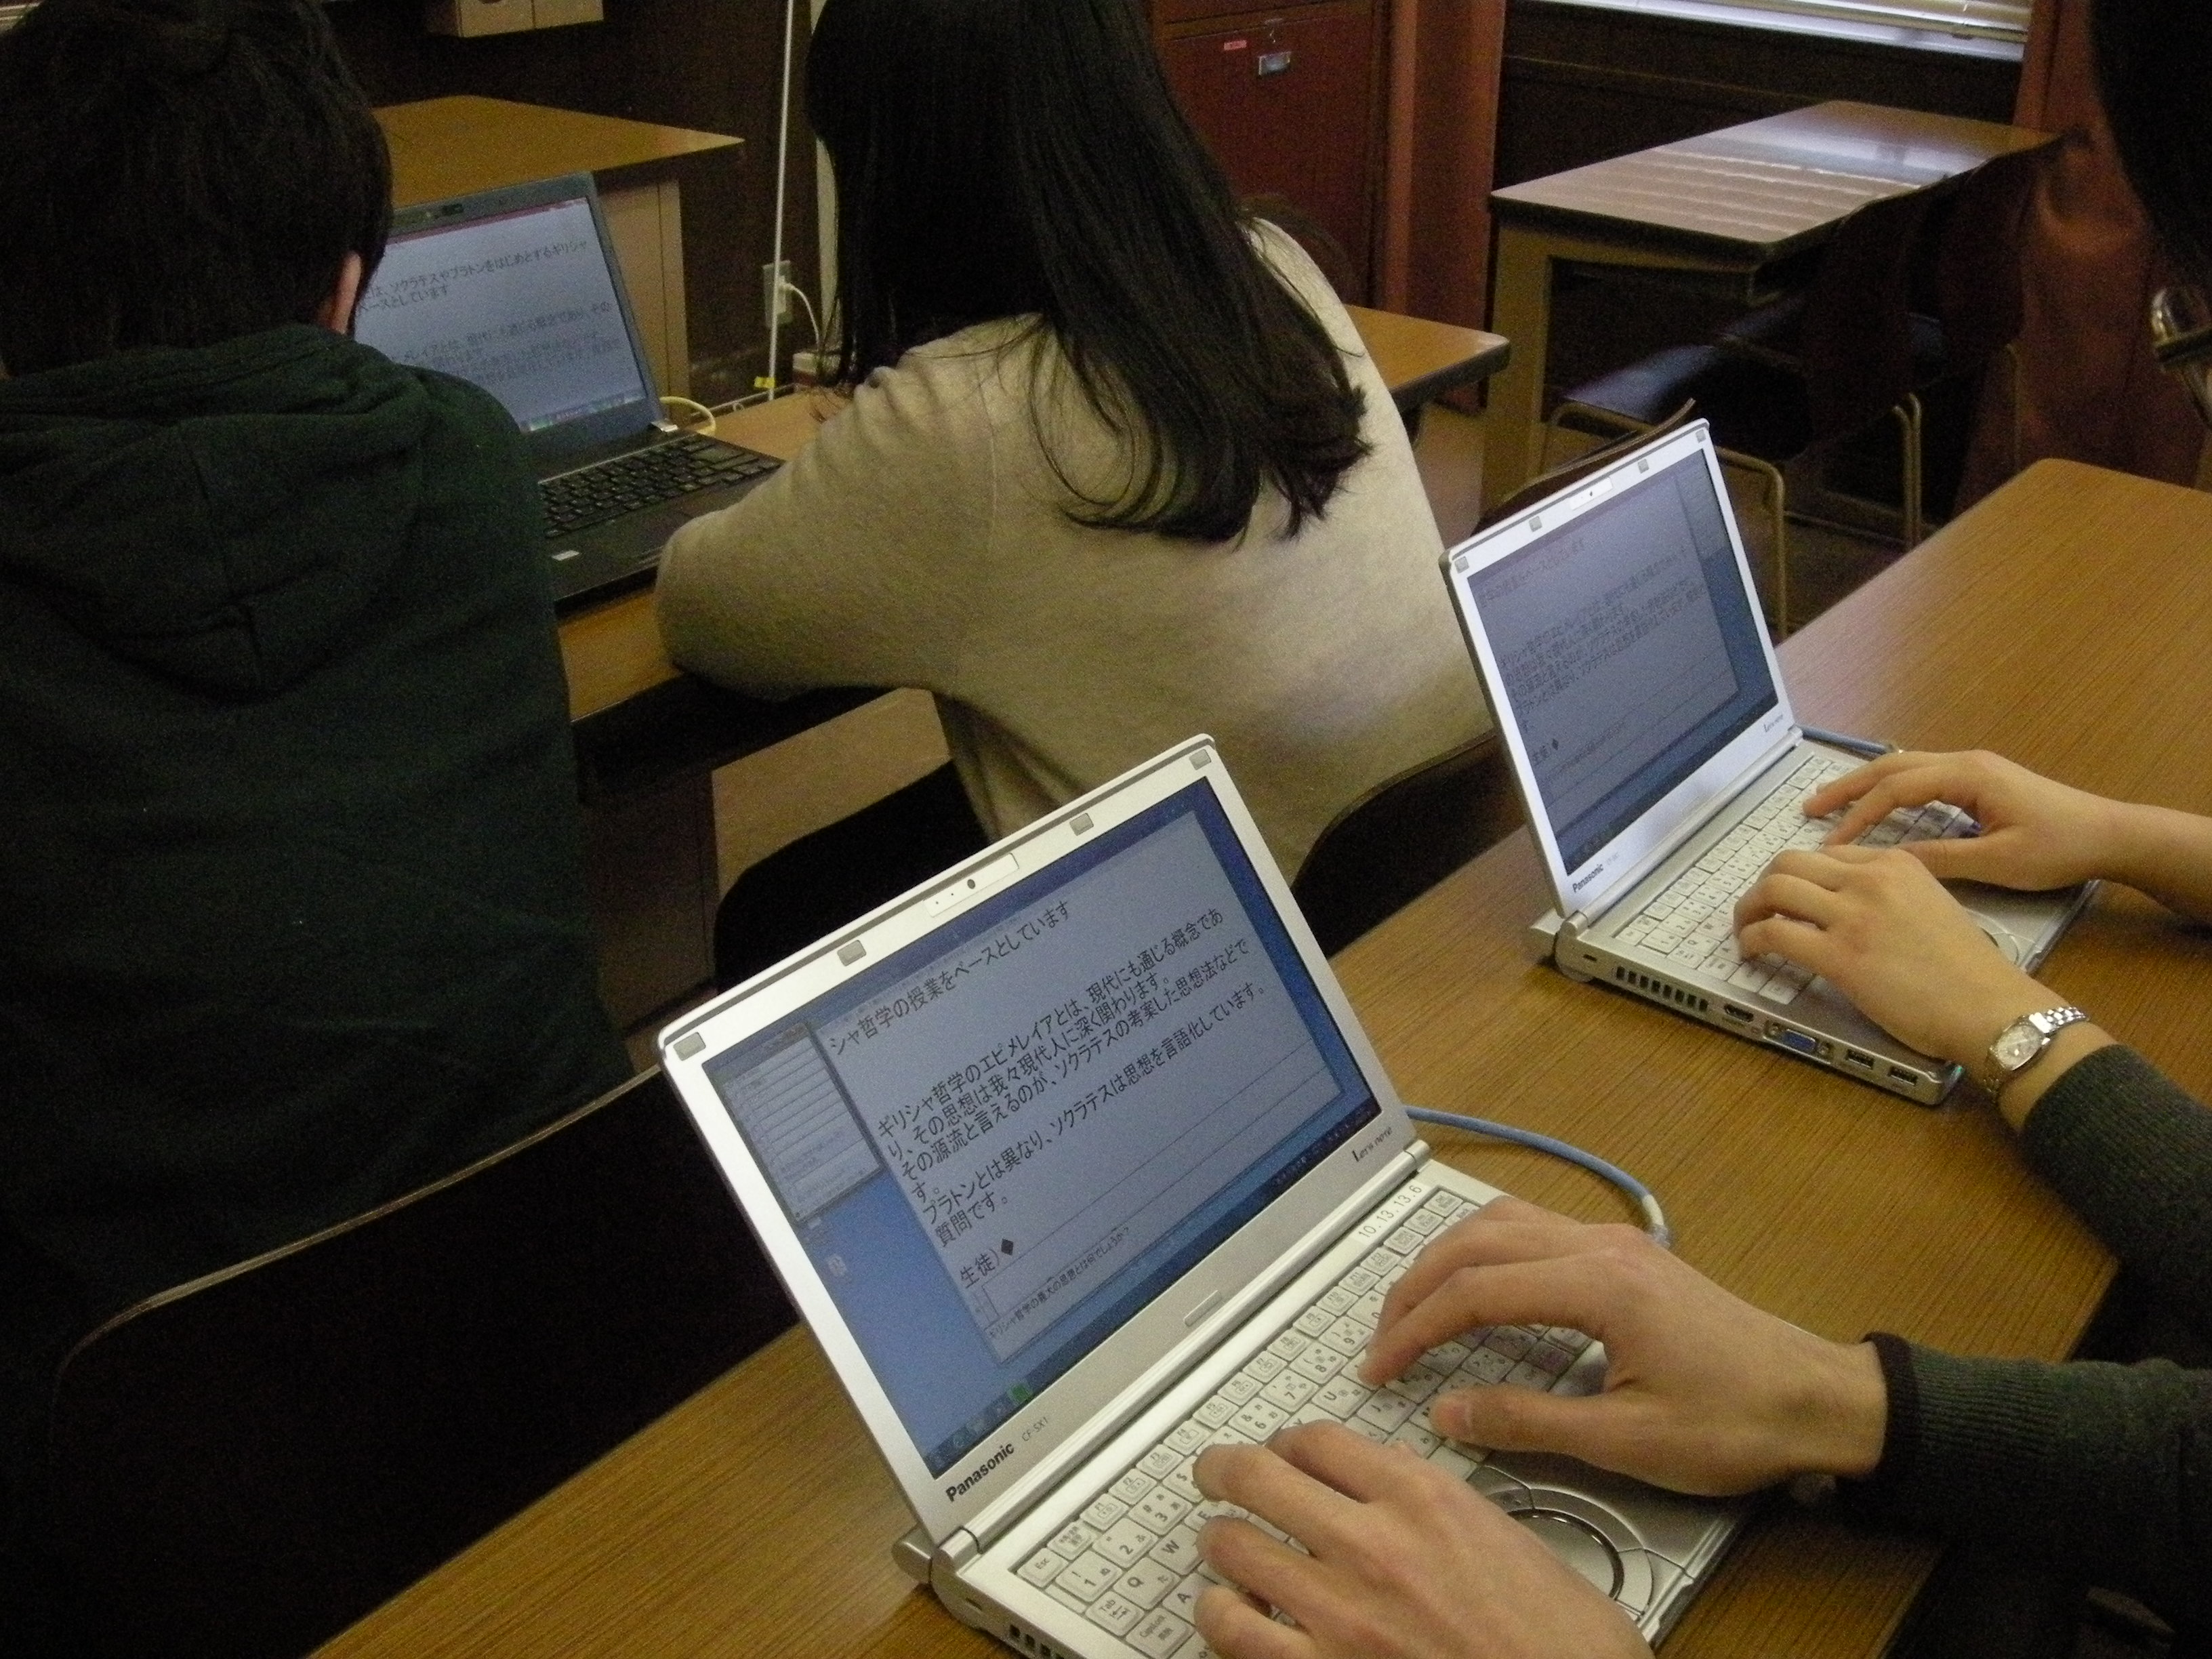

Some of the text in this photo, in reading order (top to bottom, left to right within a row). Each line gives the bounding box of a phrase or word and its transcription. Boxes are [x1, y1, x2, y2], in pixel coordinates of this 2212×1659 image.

[1572, 863, 1604, 893] Panasonic
[830, 901, 1071, 1054] シャ哲学の授業をベースとしています
[876, 908, 1222, 1140] ギリシャ哲学のエピメレイアとは、現代にも通じる概念であ
[888, 968, 1168, 1160] り、その思想は我々現代人に深く関わります。
[900, 941, 1247, 1182] その源流と言えるのが、ソクラテスの考案した思想法などで
[923, 979, 1262, 1222] プラトンとは異なり、ソクラテスは思想を言語化しています。
[911, 1174, 939, 1204] す。
[935, 1185, 1006, 1246] 質問です。
[1358, 1185, 1422, 1239] 10.13.13.6
[1324, 1391, 1337, 1401] U
[945, 1442, 1015, 1502] Panasonic
[1155, 1512, 1168, 1522] 3
[1120, 1544, 1133, 1555] 2
[1162, 1540, 1180, 1555] W
[1035, 1558, 1050, 1570] Esc
[1127, 1576, 1144, 1588] Q
[1099, 1599, 1116, 1613] Tab
[1176, 1592, 1191, 1603] A
